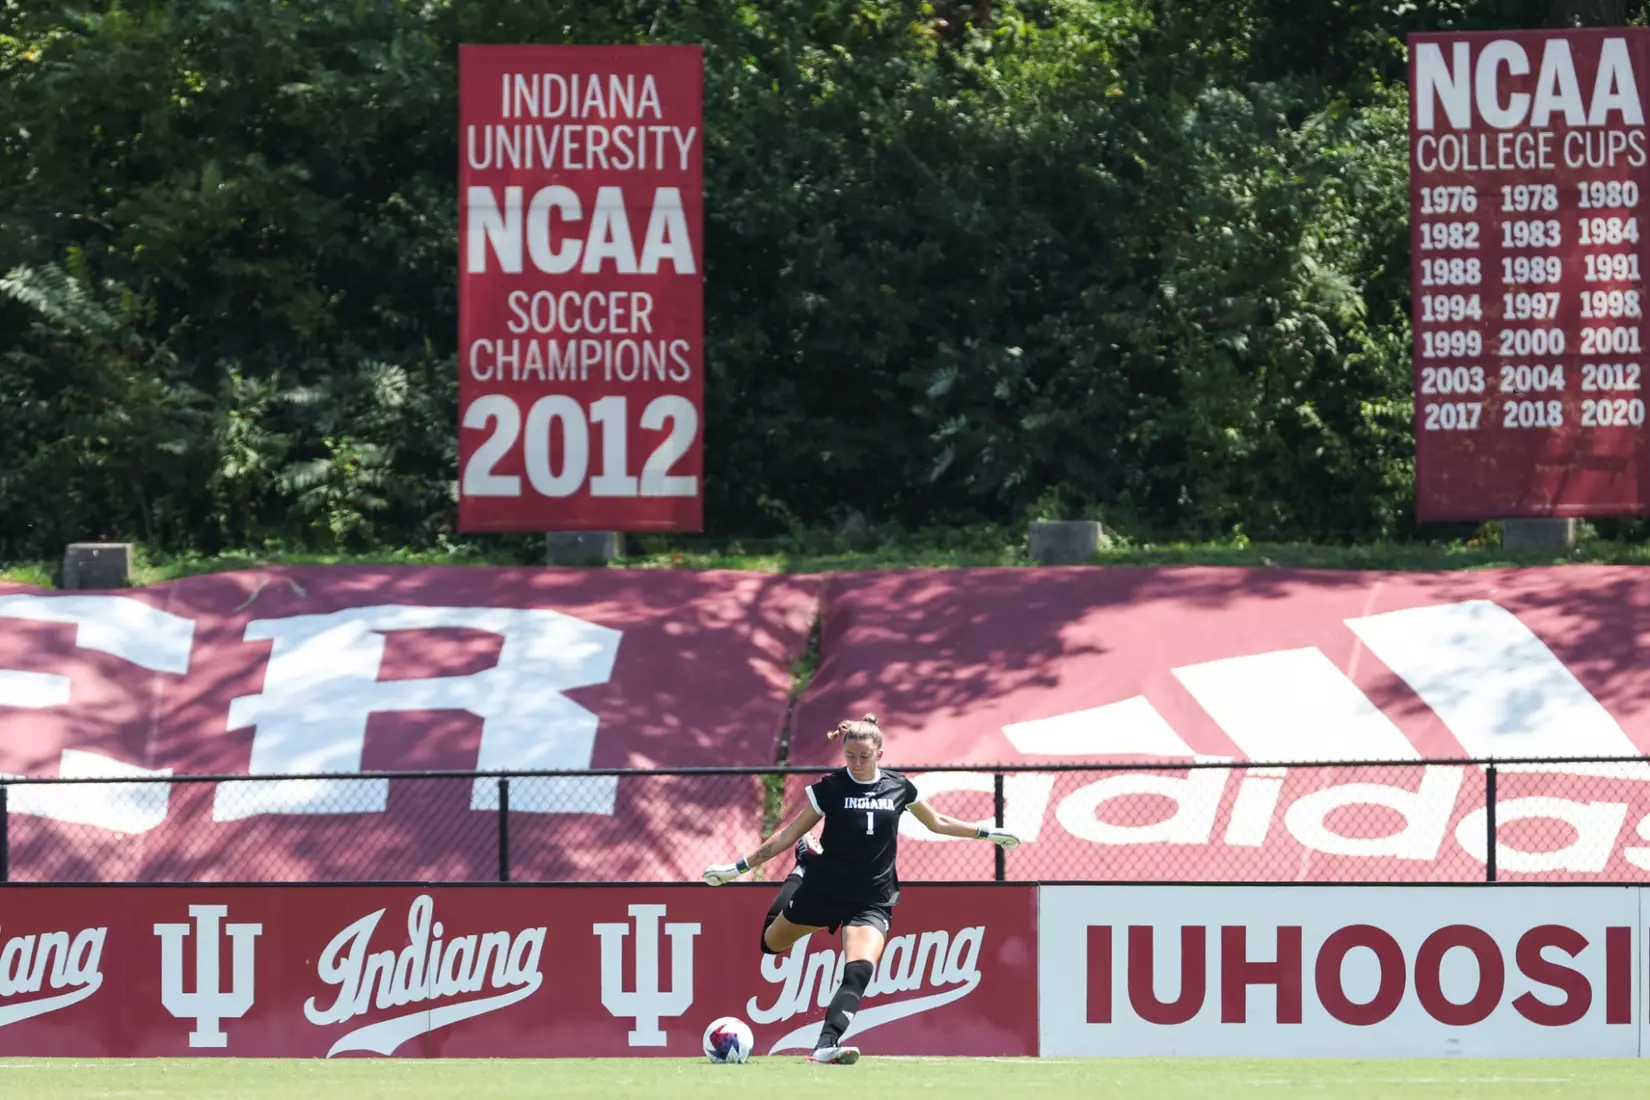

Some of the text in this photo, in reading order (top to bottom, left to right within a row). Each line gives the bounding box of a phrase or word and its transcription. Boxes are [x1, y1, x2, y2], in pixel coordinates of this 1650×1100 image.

[503, 74, 661, 118] INDIANA
[1416, 38, 1644, 130] NCAA
[468, 125, 695, 170] UNIVERSITY
[1416, 130, 1647, 172] COLLEGE CUPS
[1420, 180, 1639, 214] 1976 1978 1980
[468, 185, 695, 274] NCAA
[1420, 217, 1639, 249] 1982 1983 1984
[1421, 253, 1641, 286] 1988 1989 1991
[508, 291, 652, 333] SOCCER
[1421, 290, 1642, 322] 1994 1997 1998
[471, 339, 689, 381] CHAMPIONS
[1422, 326, 1641, 358] 1999 2000 2001
[1421, 362, 1641, 394] 2003 2004 2012
[1424, 398, 1645, 430] 2017 2018 2020
[463, 395, 697, 496] 2012
[844, 797, 895, 811] INDIANA
[866, 812, 874, 835] 1
[898, 754, 1650, 876] adida
[303, 894, 547, 1059] Indiana
[746, 925, 985, 1056] Inana
[1086, 923, 1650, 1026] IUHOOSI
